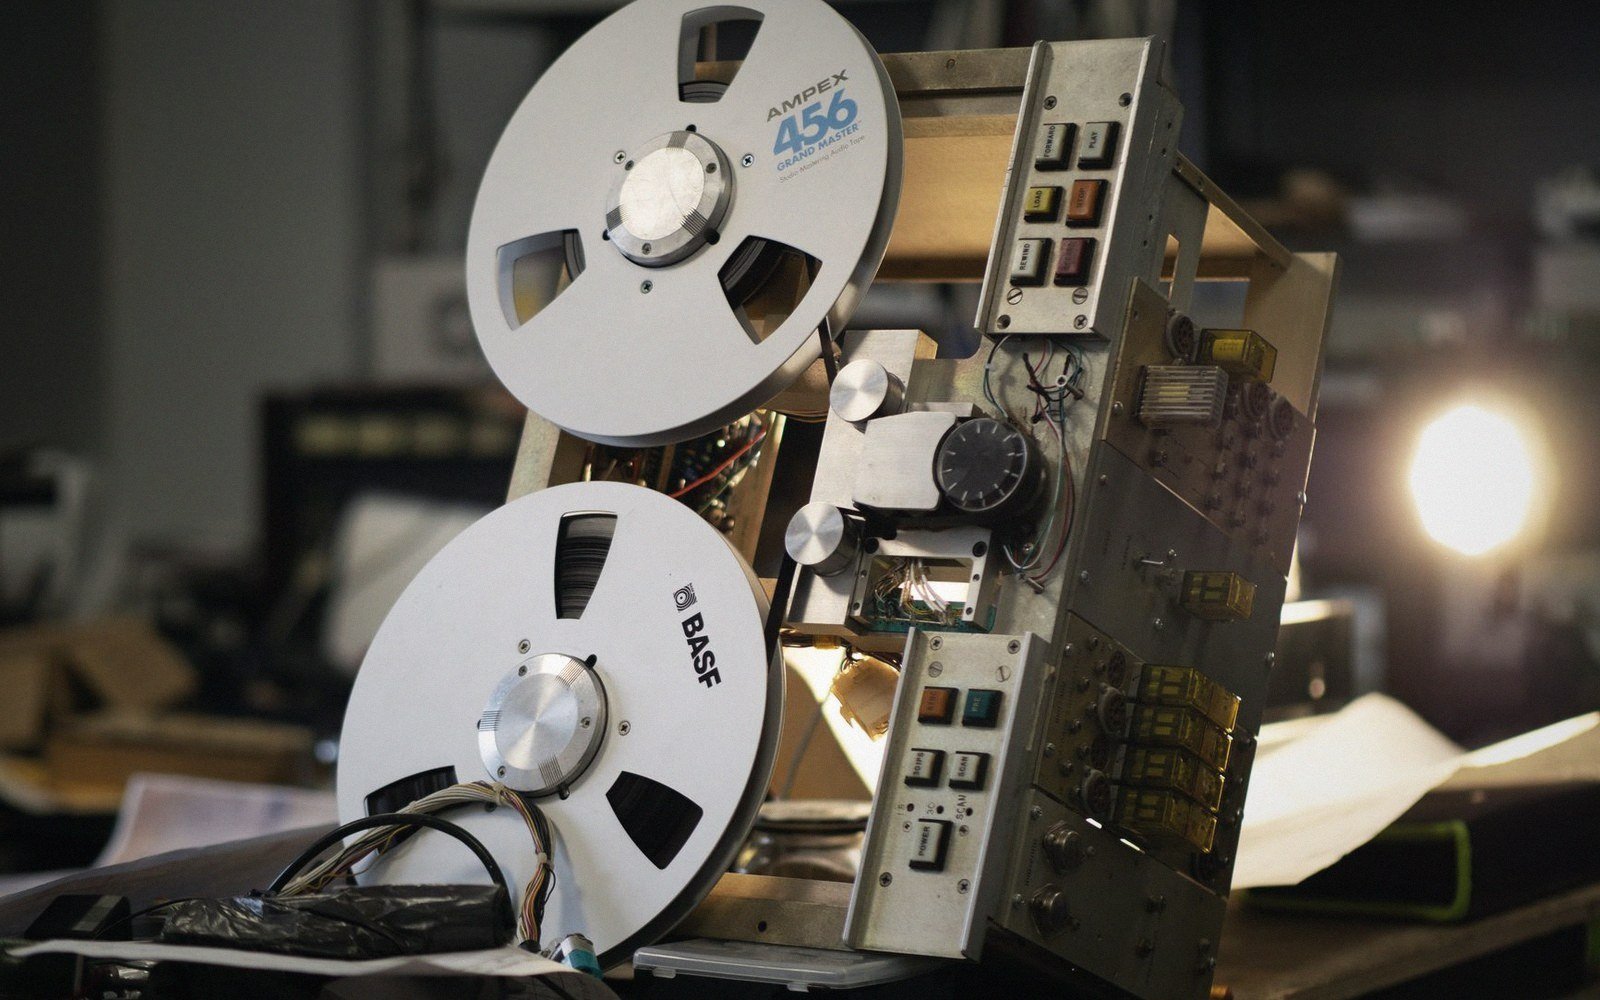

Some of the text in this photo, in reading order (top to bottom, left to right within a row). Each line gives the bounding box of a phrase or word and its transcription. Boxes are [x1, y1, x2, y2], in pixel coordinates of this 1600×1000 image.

[767, 69, 848, 122] AMPEX
[773, 88, 858, 155] 456
[777, 123, 859, 171] GRAND MASTER
[1044, 124, 1056, 158] FORWARD
[1089, 131, 1098, 149] PLAY
[780, 168, 799, 183] Studio
[1033, 190, 1042, 208] LOAD
[1019, 243, 1031, 271] REWIND
[681, 611, 722, 688] BASF
[958, 756, 968, 777] SCAN
[927, 801, 935, 815] 30
[956, 794, 967, 820] SCAN
[918, 826, 931, 857] POWER
